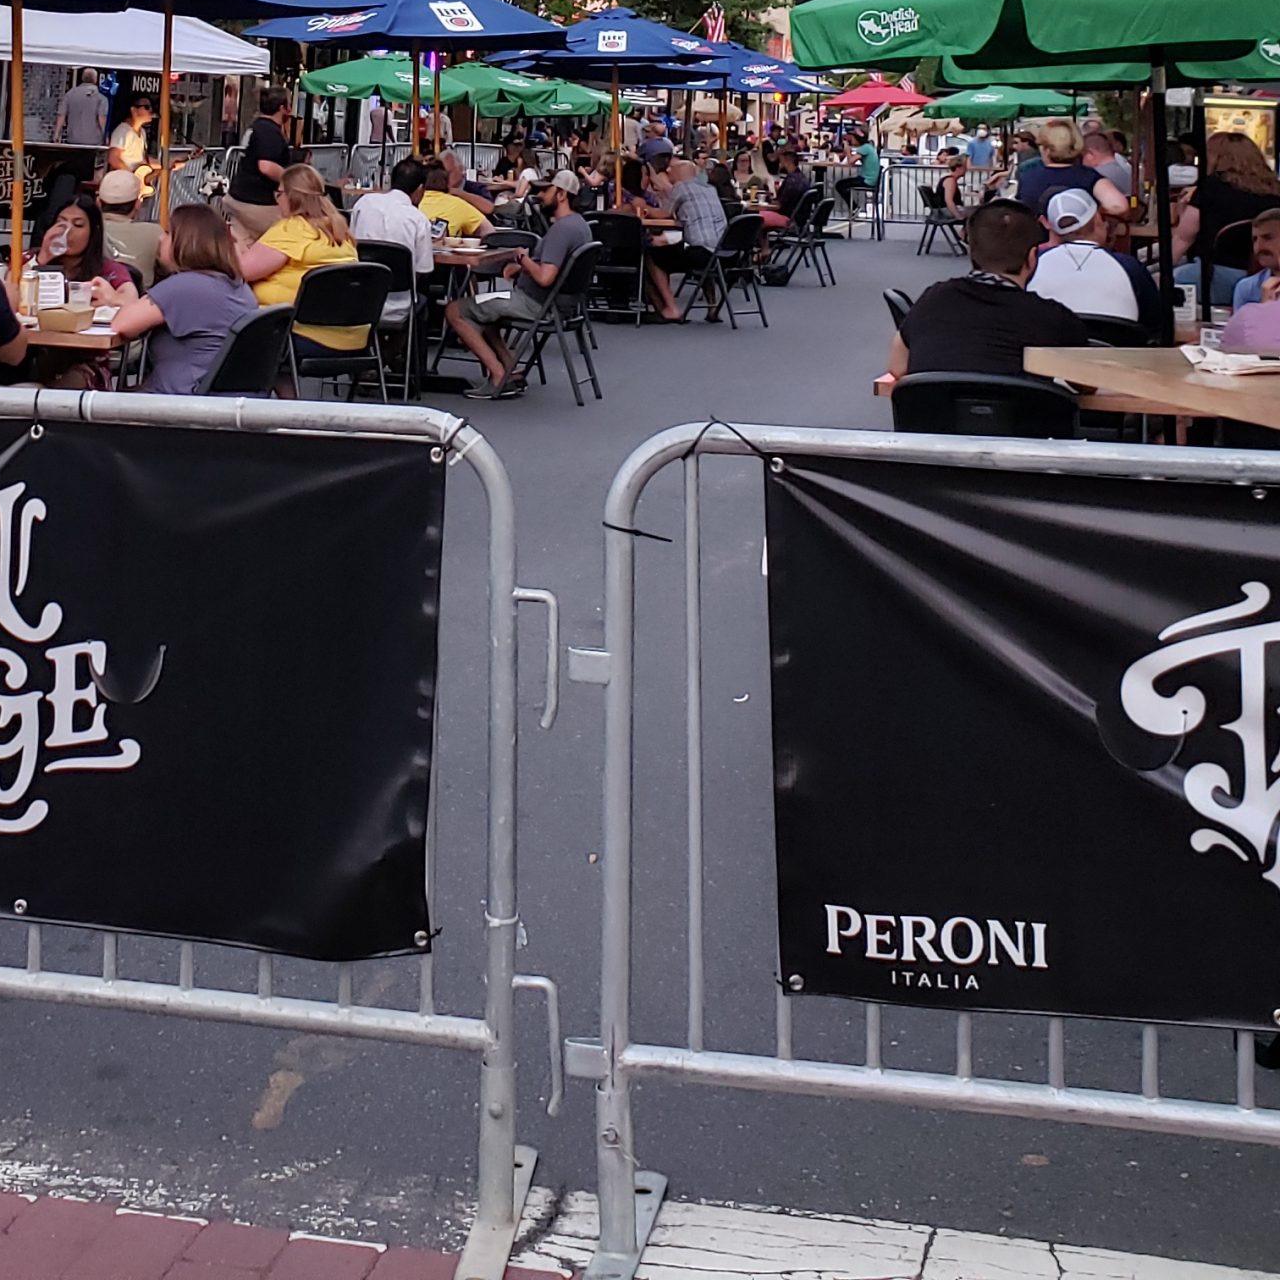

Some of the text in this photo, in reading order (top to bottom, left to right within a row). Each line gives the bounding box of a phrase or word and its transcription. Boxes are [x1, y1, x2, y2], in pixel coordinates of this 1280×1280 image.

[880, 7, 915, 24] Dogfish
[889, 14, 920, 37] Head
[132, 75, 160, 93] NOSH
[824, 904, 1048, 968] PERONI
[891, 970, 980, 990] ITALIA
